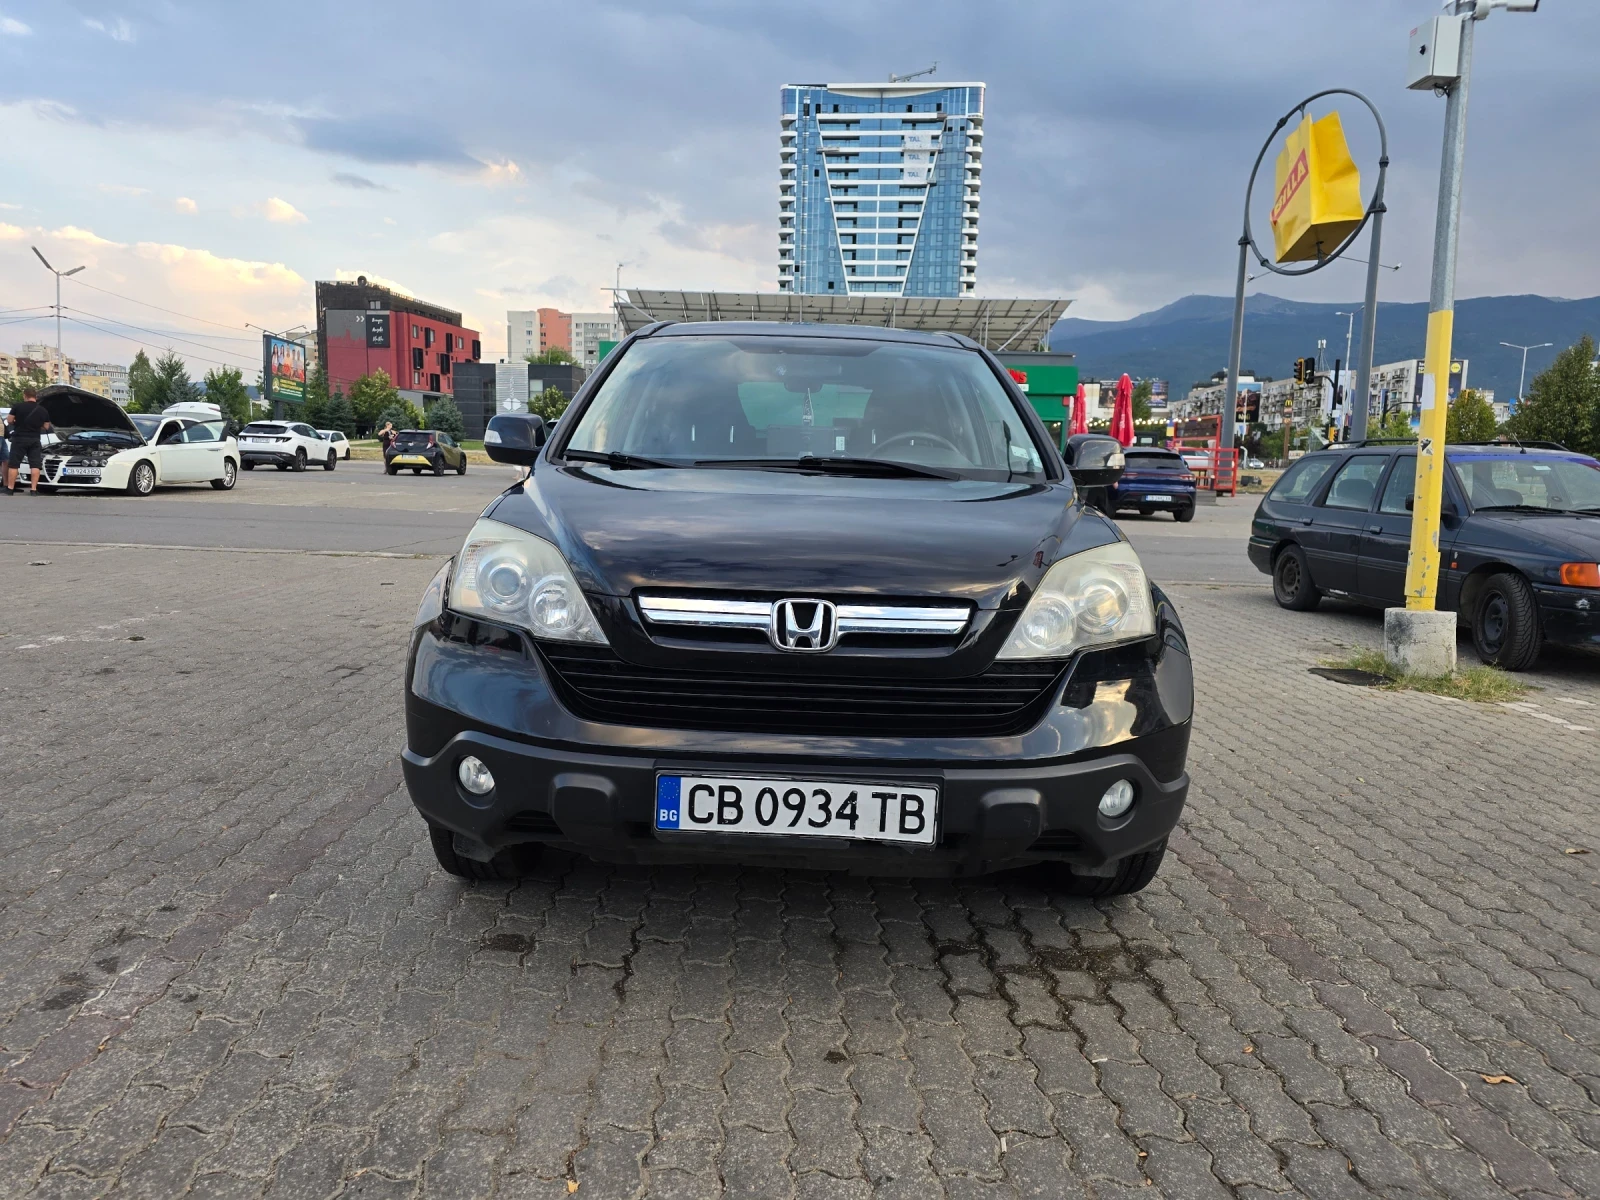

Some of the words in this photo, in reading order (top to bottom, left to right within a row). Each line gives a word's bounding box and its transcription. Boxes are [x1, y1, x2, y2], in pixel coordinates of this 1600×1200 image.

[1273, 158, 1307, 217] BILLA
[659, 809, 677, 821] BG
[688, 783, 744, 825] CB
[754, 787, 860, 831] 0934
[871, 791, 925, 835] TB
